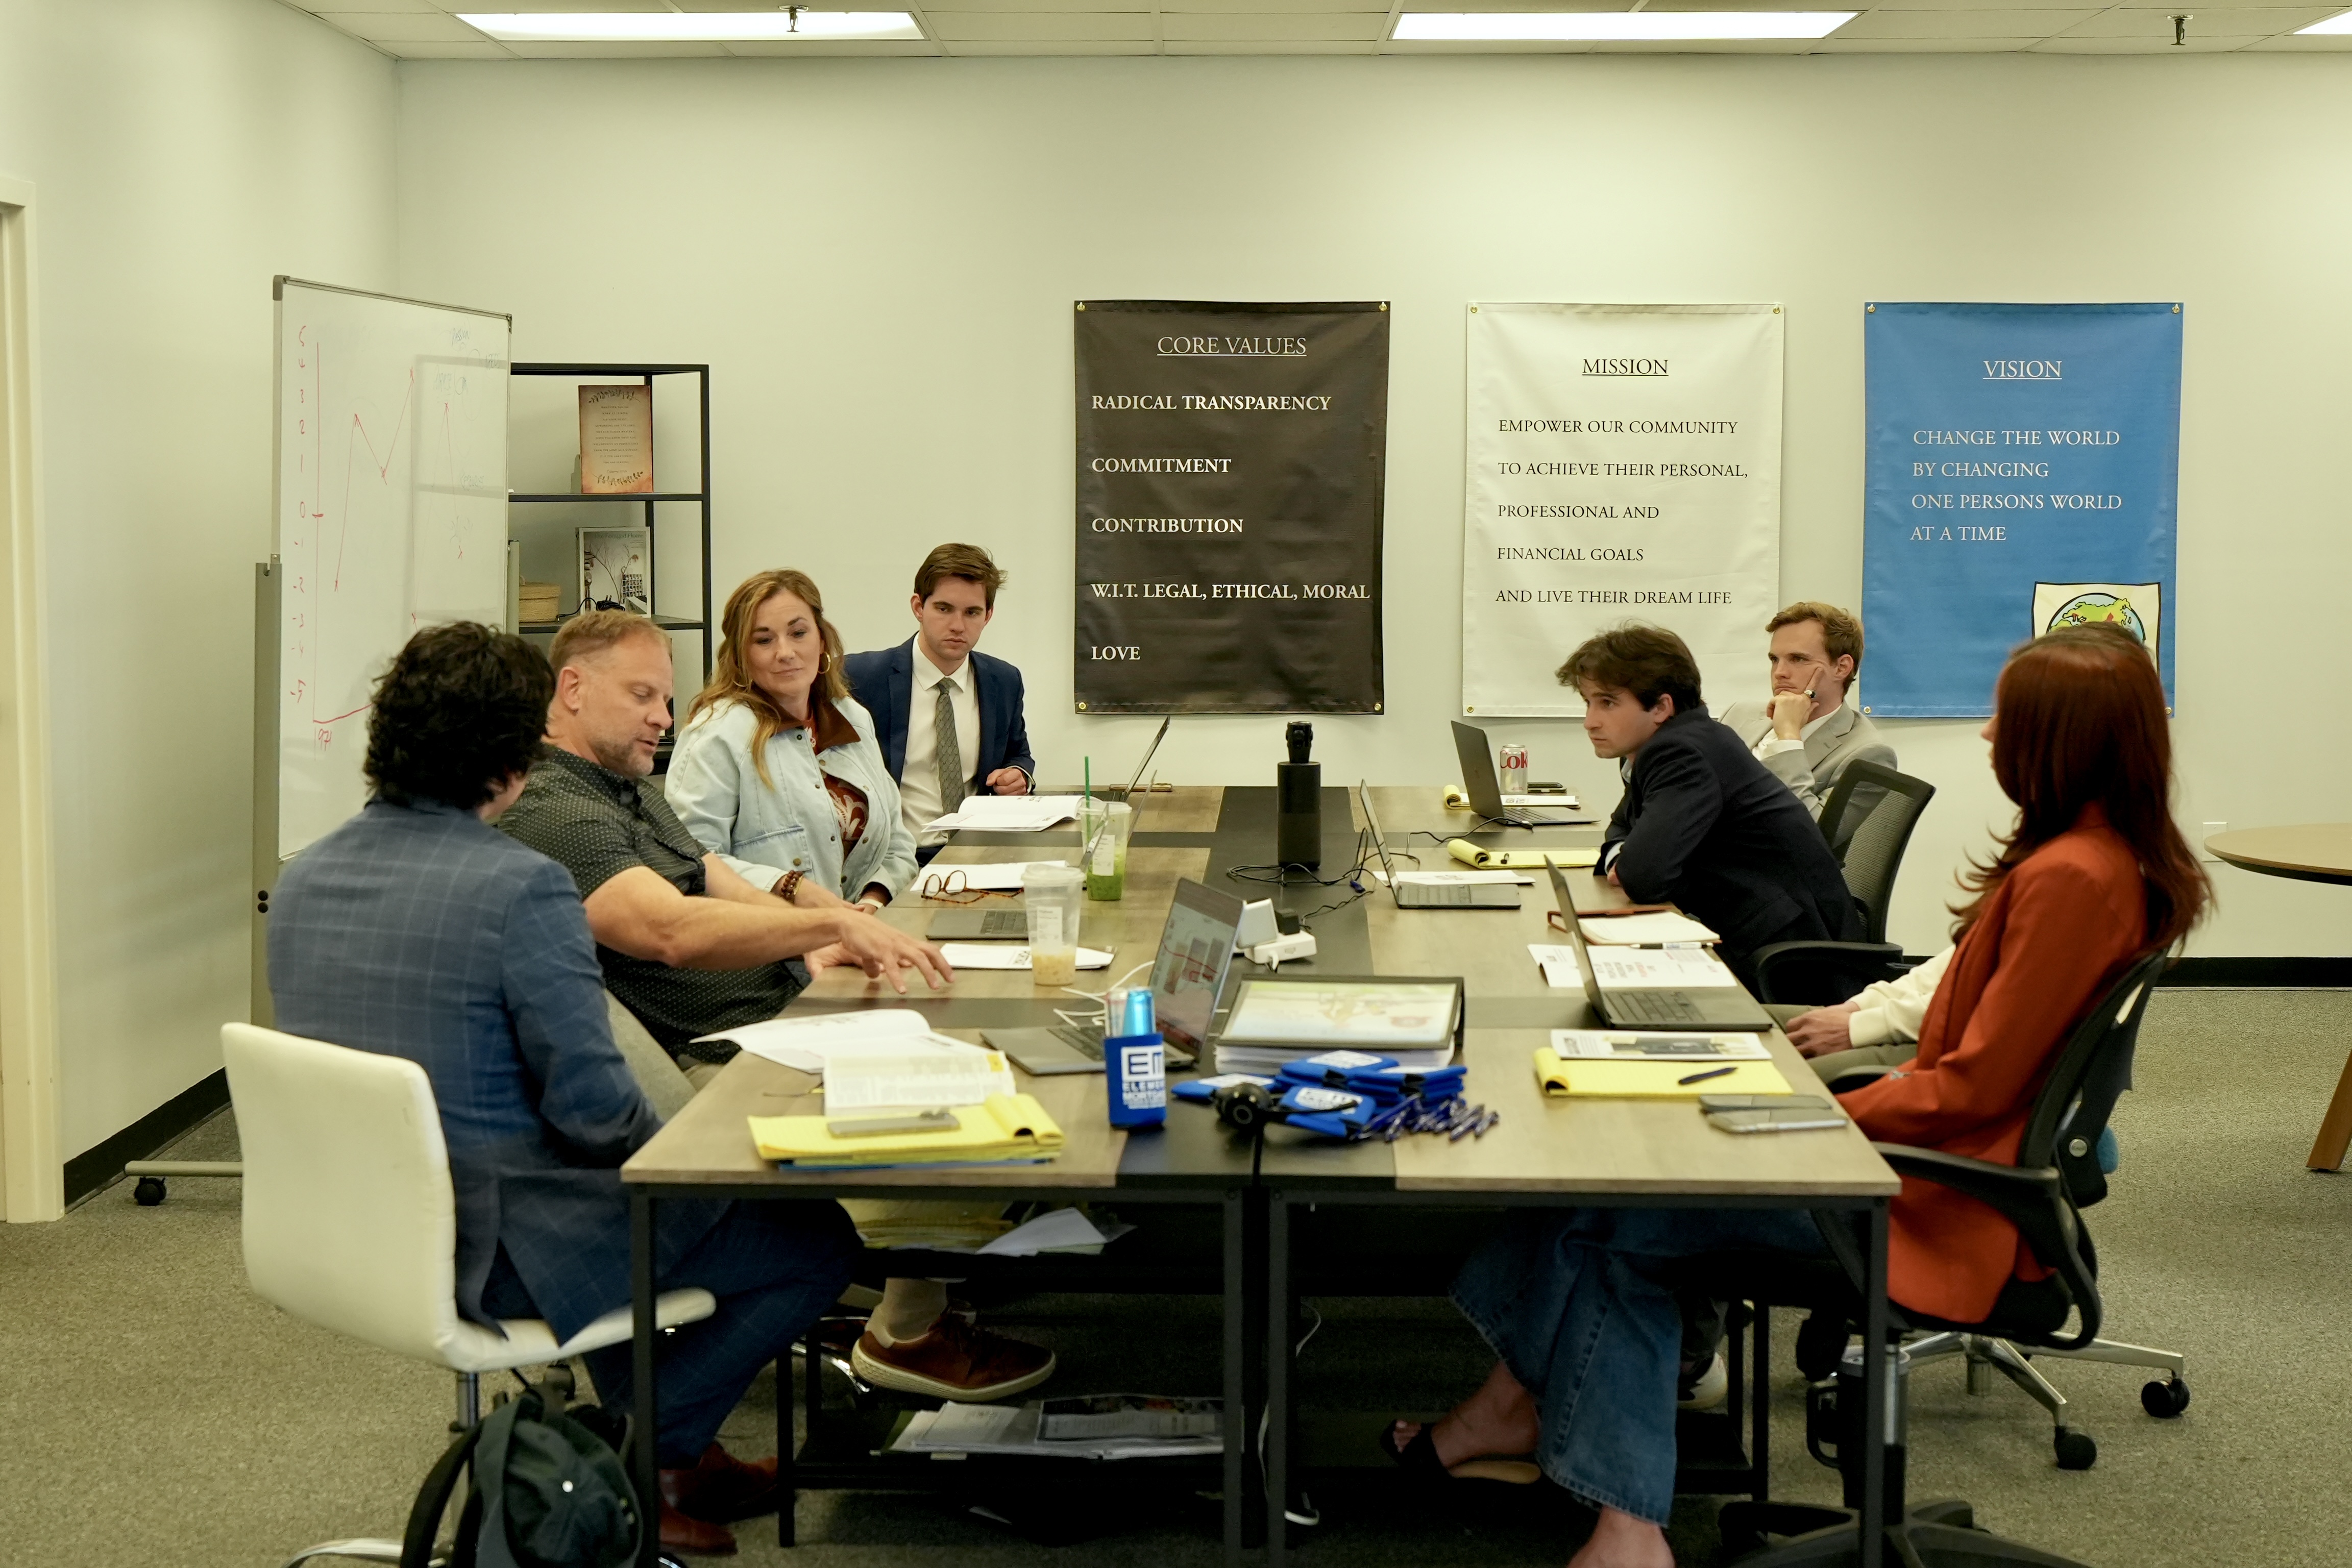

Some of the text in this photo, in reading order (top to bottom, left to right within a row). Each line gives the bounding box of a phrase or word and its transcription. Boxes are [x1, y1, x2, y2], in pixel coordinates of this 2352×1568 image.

[1158, 336, 1306, 354] CORE VALUES
[1582, 358, 1669, 374] MISSION
[1983, 360, 2063, 378] VISION
[1091, 395, 1332, 410] RADICAL TRANSPARENCY
[299, 419, 305, 435] 2
[1499, 420, 1738, 434] EMPOWER OUR COMMUNITY
[1913, 430, 2120, 445] CHANGE THE WORLD
[1091, 458, 1232, 473] COMMITMENT
[1498, 462, 1748, 478] TO ACHIEVE THEIR PERSONAL,
[1913, 462, 2049, 477] BY CHANGING
[1912, 494, 2122, 509] ONE PERSONS WORLD
[300, 501, 306, 519] 0
[1498, 505, 1659, 519] PROFESSIONAL AND
[1092, 518, 1244, 533] CONTRIBUTION
[1909, 526, 2006, 541] AT A TIME
[1497, 547, 1644, 561] FINANCIAL GOALS
[1090, 583, 1370, 601] W.I.T. LEGAL, ETHICAL, MORAL
[1495, 590, 1732, 604] AND LIVE THEIR DREAM LIFE
[1091, 646, 1141, 660] LOVE
[1500, 750, 1528, 769] Cok
